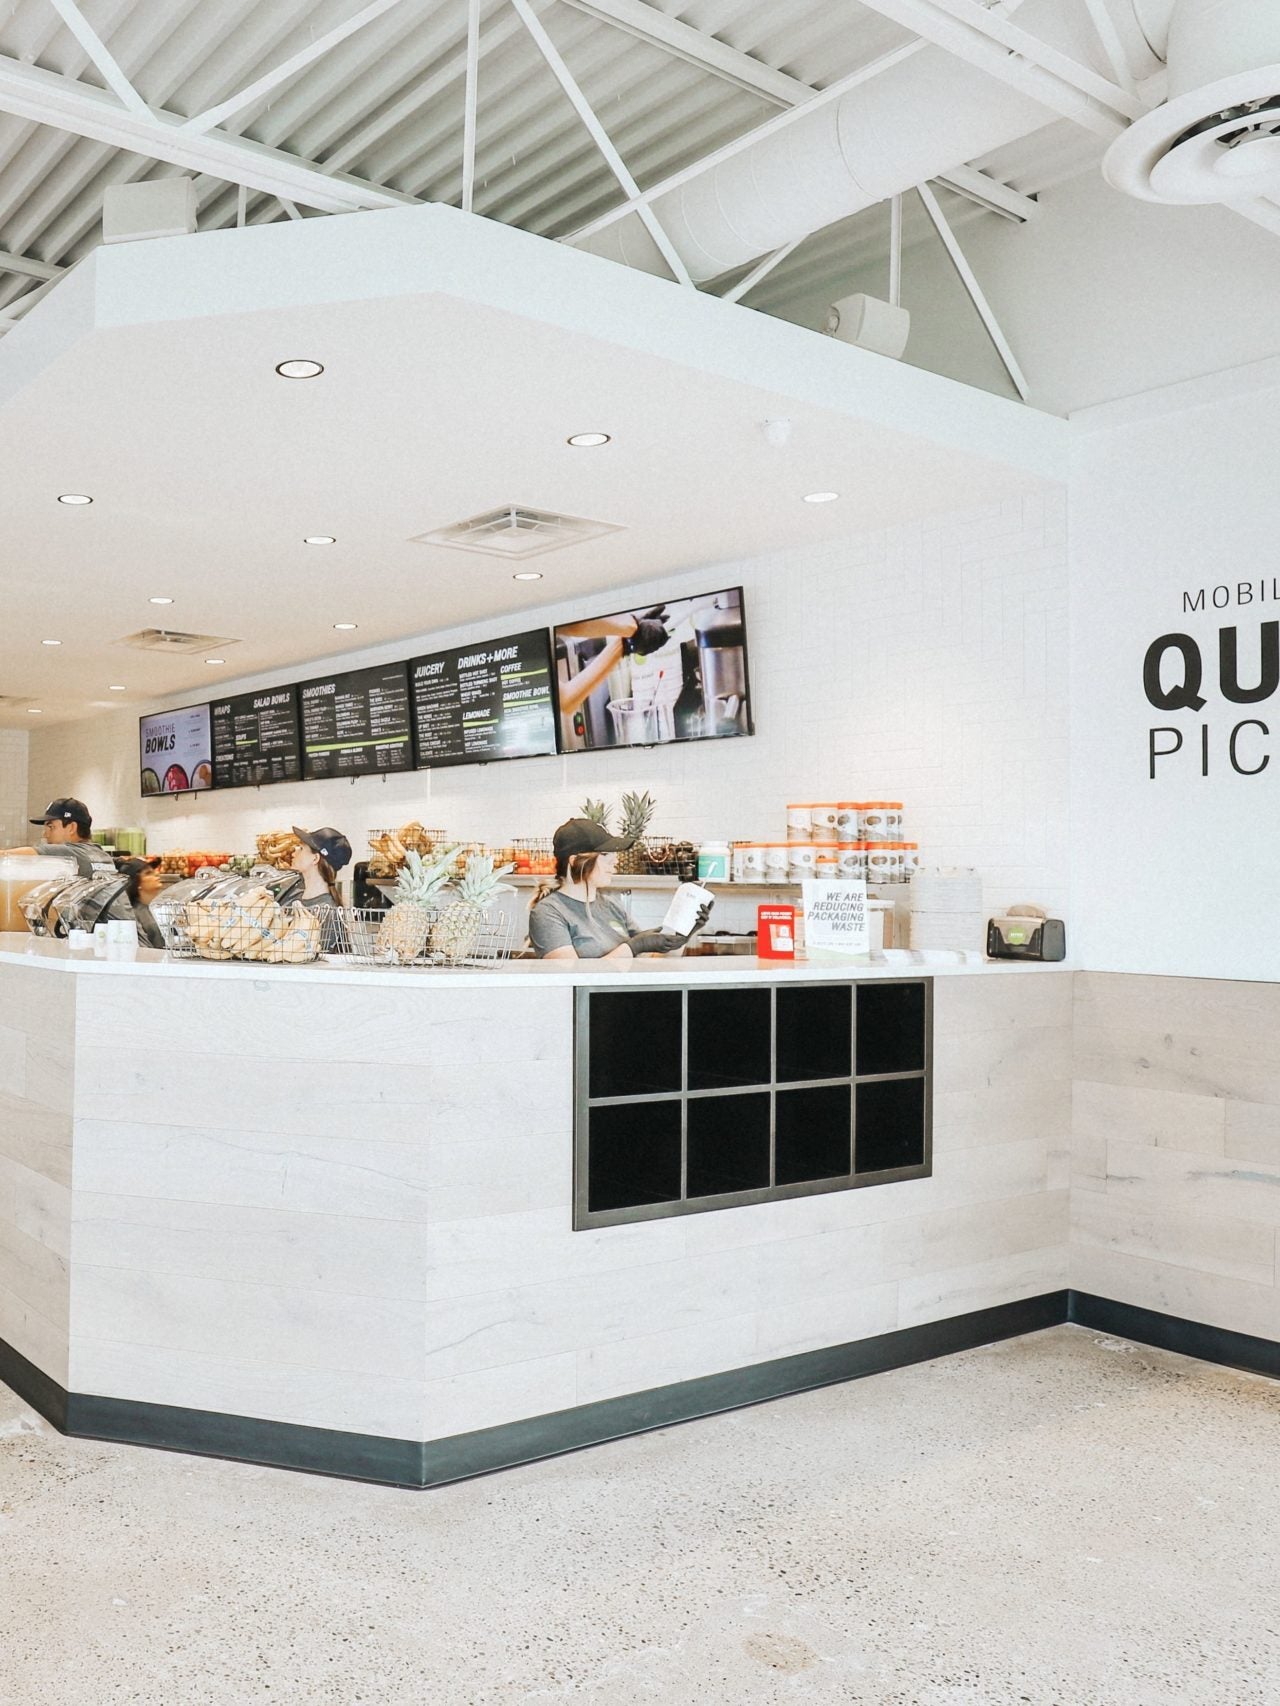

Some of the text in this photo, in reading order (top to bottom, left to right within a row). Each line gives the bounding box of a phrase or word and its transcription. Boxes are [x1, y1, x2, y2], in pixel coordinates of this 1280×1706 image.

[414, 661, 446, 679] JUICERY
[500, 662, 523, 674] COFFEE
[1142, 620, 1280, 713] QU
[302, 683, 336, 699] SMOOTHIES
[503, 688, 533, 701] SMOOTHIE
[253, 692, 291, 709] SALAD BOWLS
[462, 708, 491, 721] LEMONADE
[145, 723, 176, 738] SMOOTHIE
[145, 733, 176, 754] BOWLS
[1149, 719, 1271, 780] PIC
[826, 892, 864, 902] WE ARE
[813, 902, 864, 912] REDUCING
[807, 911, 865, 922] PACKAGING
[831, 922, 866, 932] WASTE
